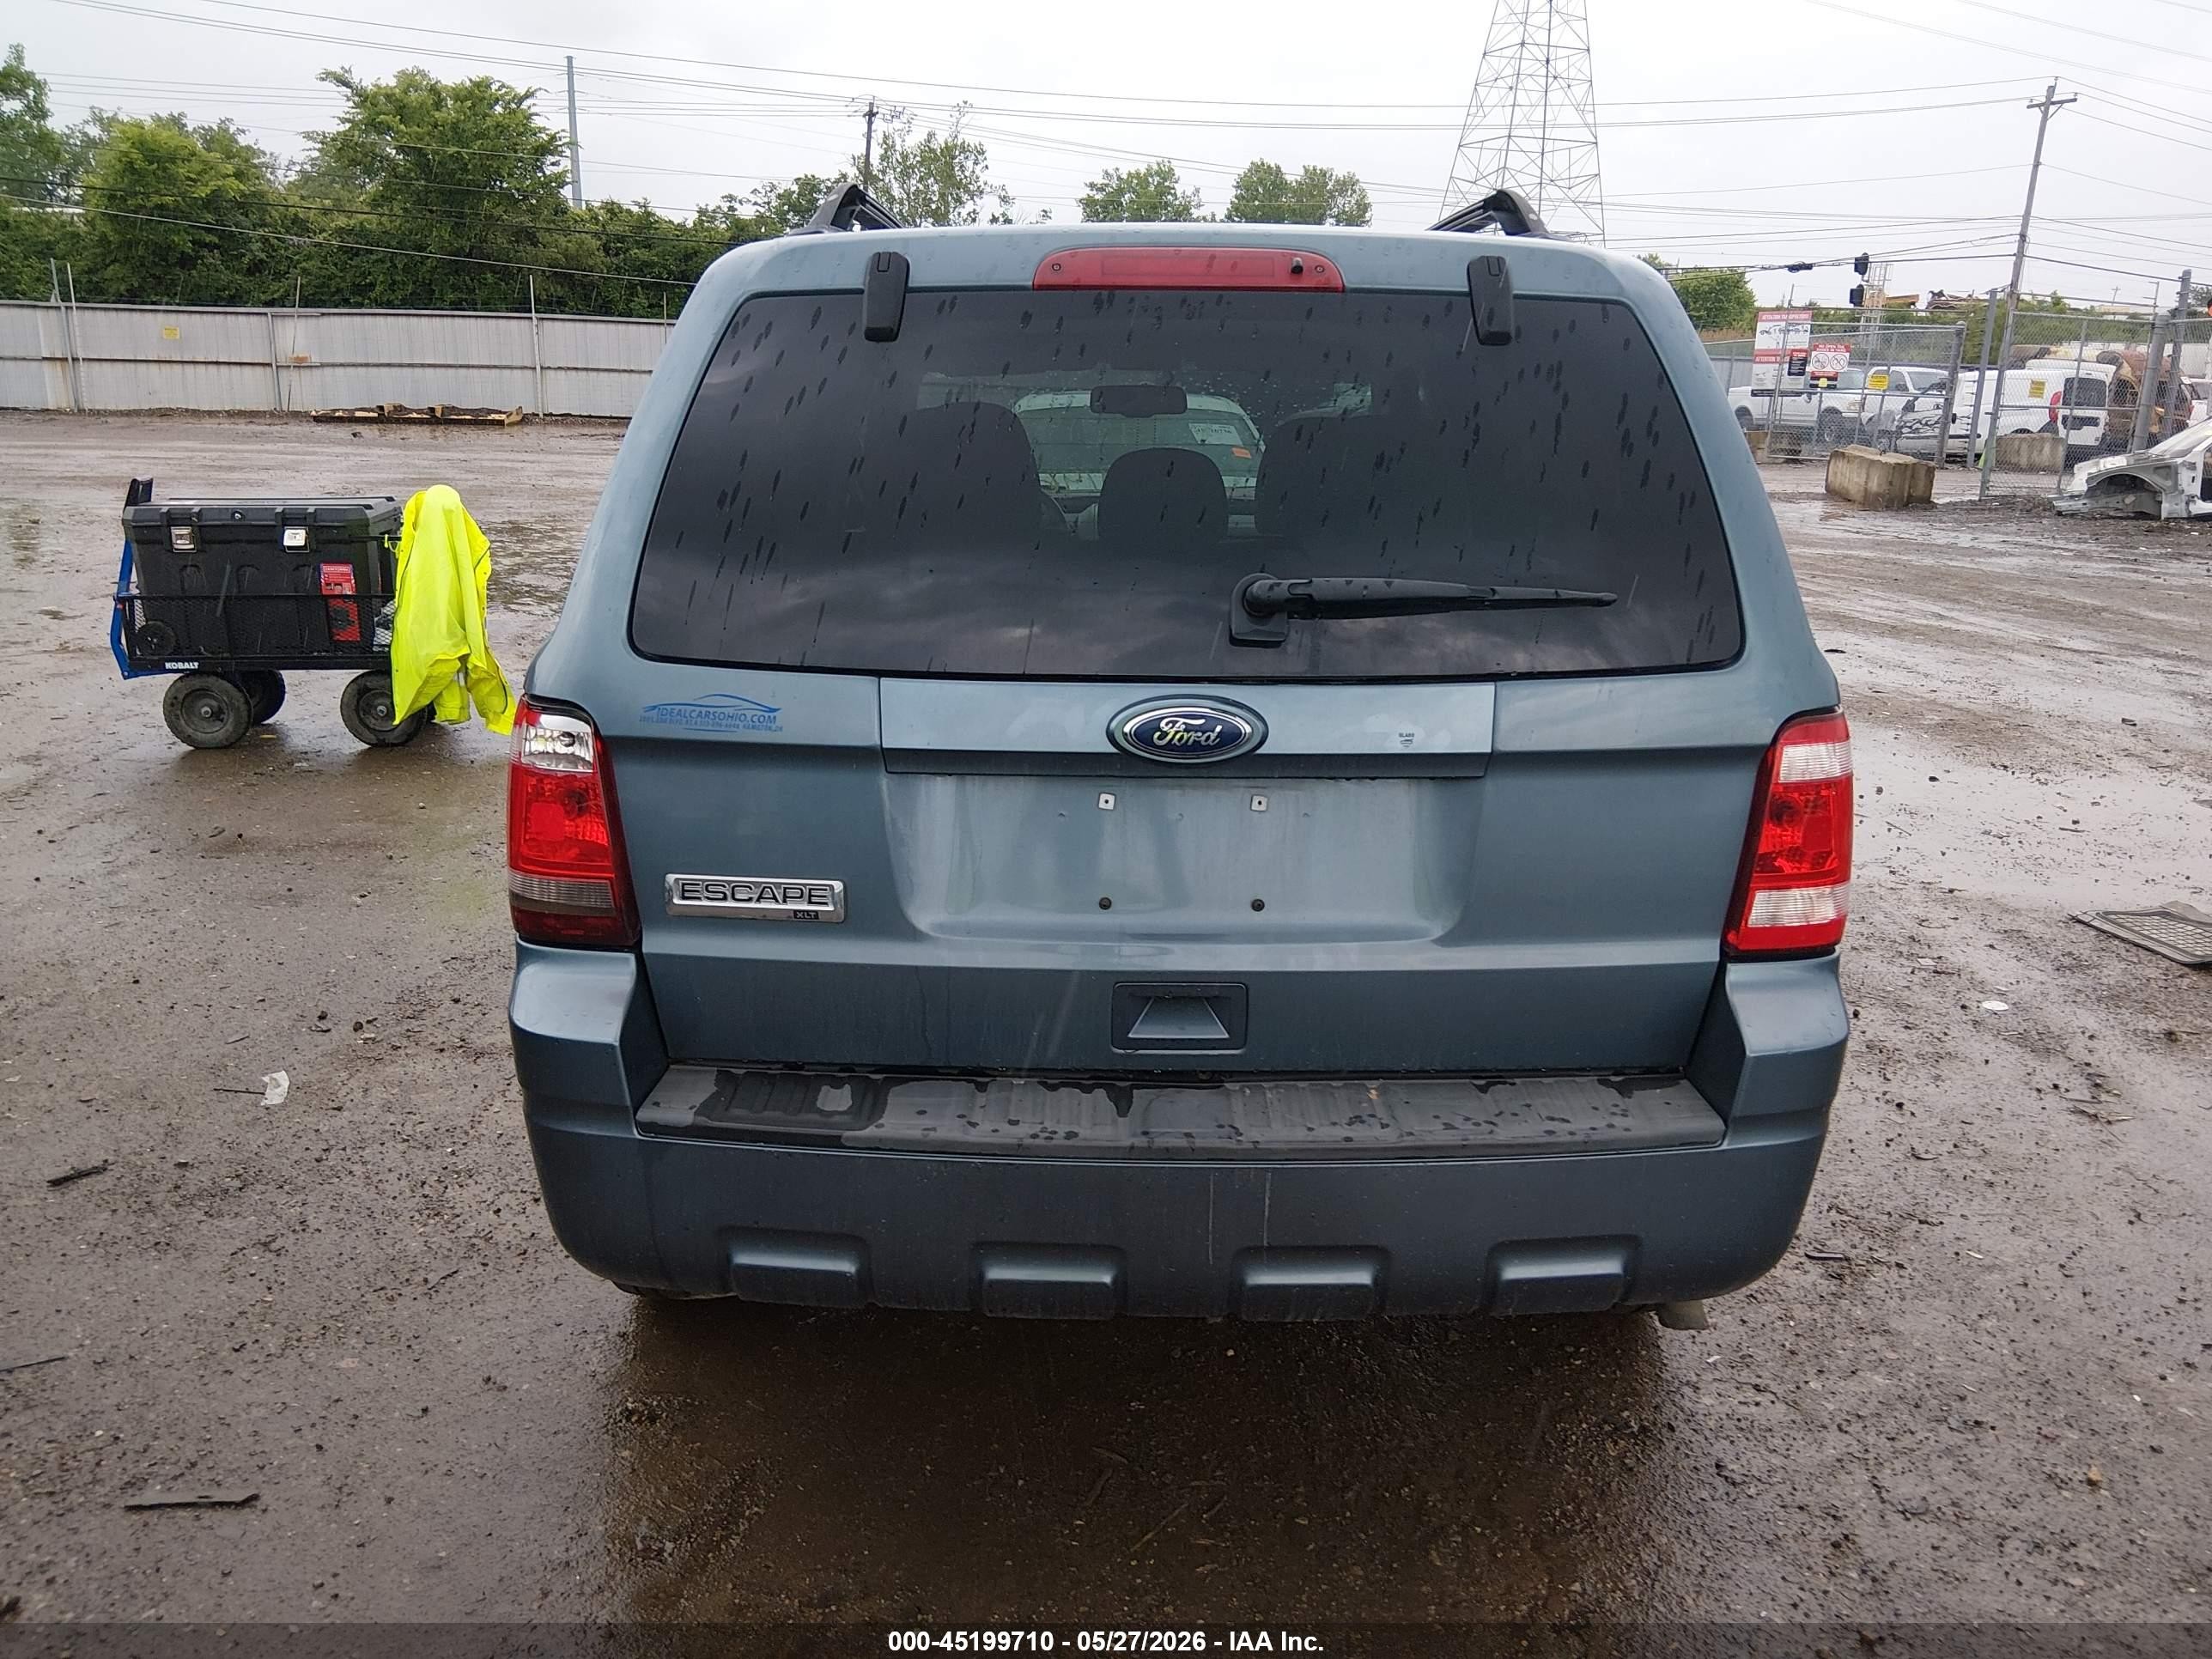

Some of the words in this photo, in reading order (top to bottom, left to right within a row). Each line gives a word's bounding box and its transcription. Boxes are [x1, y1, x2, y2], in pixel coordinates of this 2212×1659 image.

[165, 661, 199, 670] KOBALT
[657, 707, 777, 725] IDEALCARSOHIO.COM
[1152, 716, 1224, 747] Ford
[679, 881, 831, 908] ESCAPE
[795, 910, 818, 921] XLT
